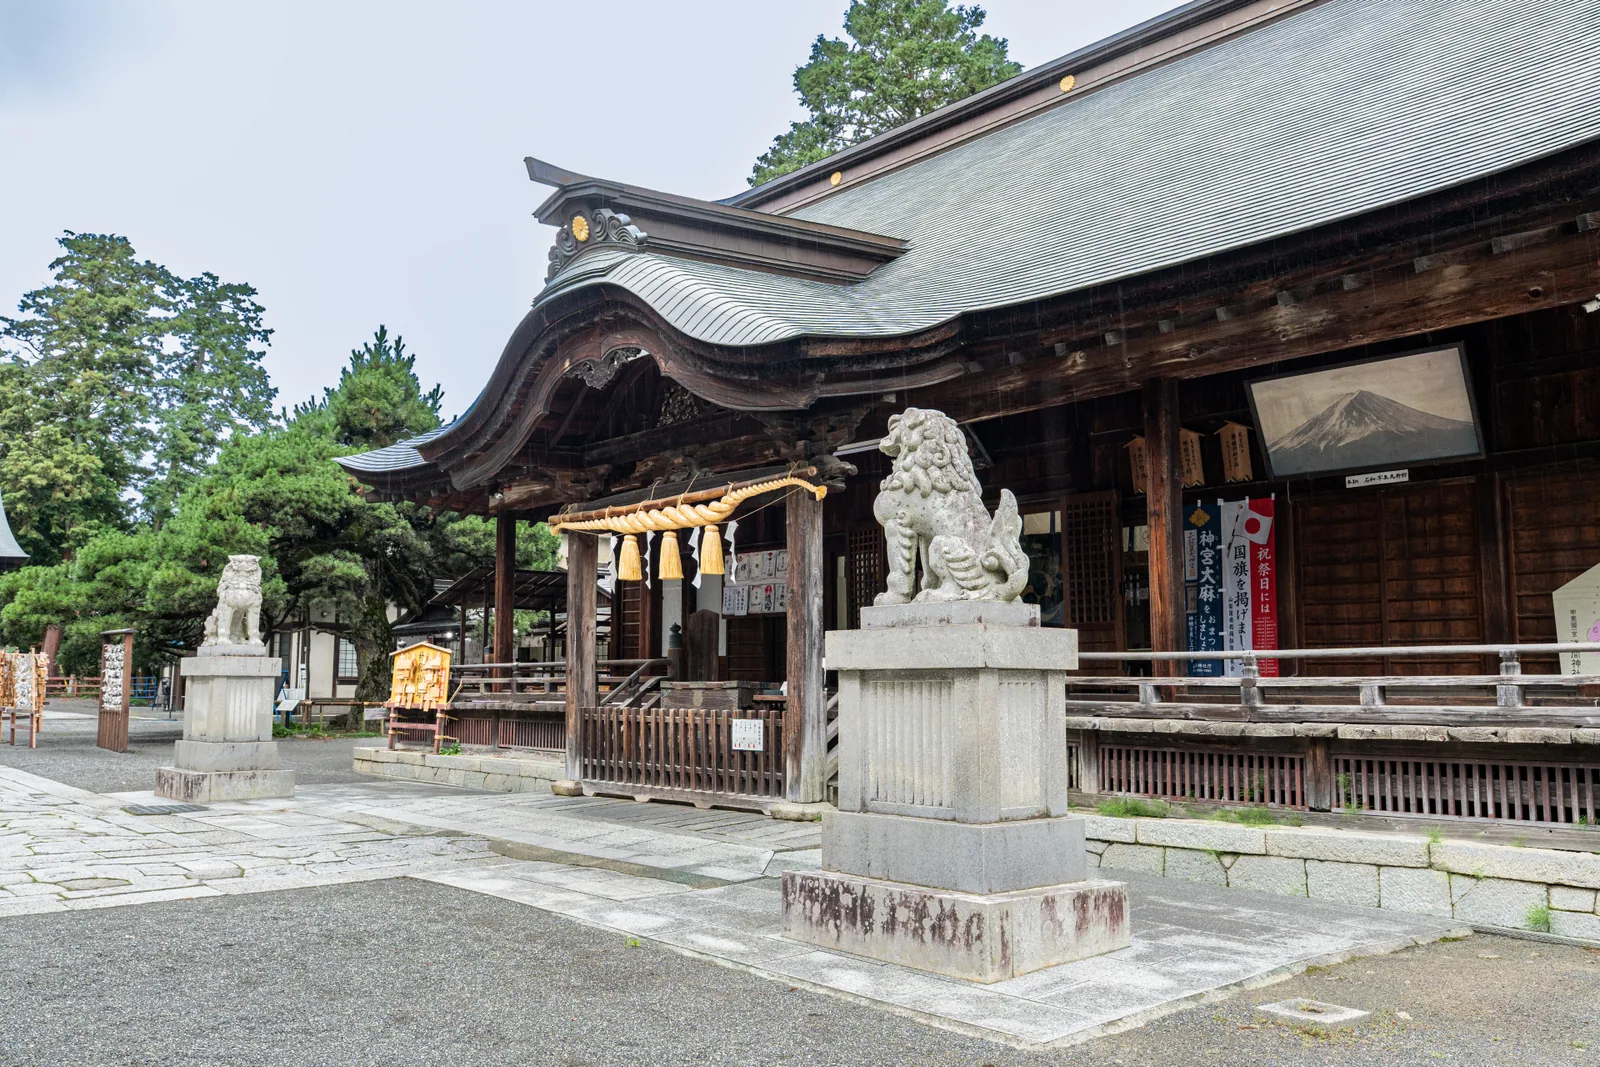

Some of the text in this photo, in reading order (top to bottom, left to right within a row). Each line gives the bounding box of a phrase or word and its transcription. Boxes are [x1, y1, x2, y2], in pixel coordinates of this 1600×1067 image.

[1198, 530, 1217, 614] 神宮大麻を
[1232, 544, 1250, 676] 国旗を掲げまし
[1256, 547, 1272, 614] 祝祭日には
